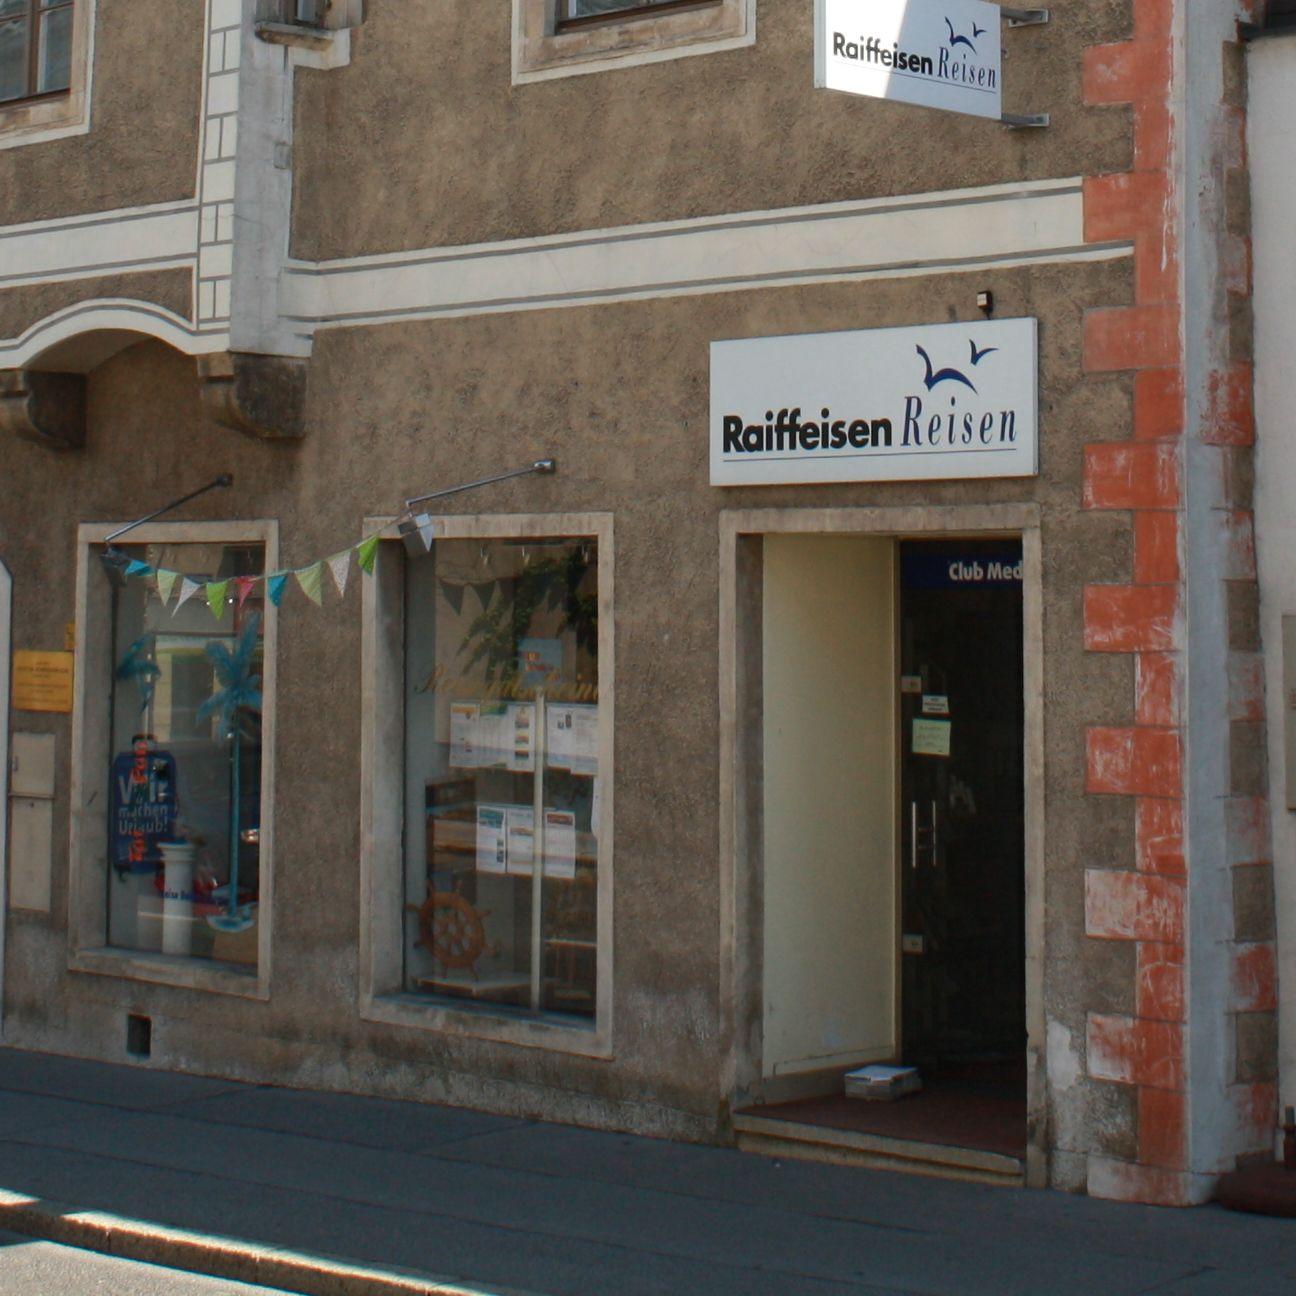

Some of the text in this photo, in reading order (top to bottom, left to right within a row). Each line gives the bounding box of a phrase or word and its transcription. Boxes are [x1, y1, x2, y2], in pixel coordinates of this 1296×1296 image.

[832, 31, 996, 89] Raiffeisen Reisen
[722, 395, 1018, 453] Raiffeisen Reisen
[948, 560, 1024, 581] Club Med
